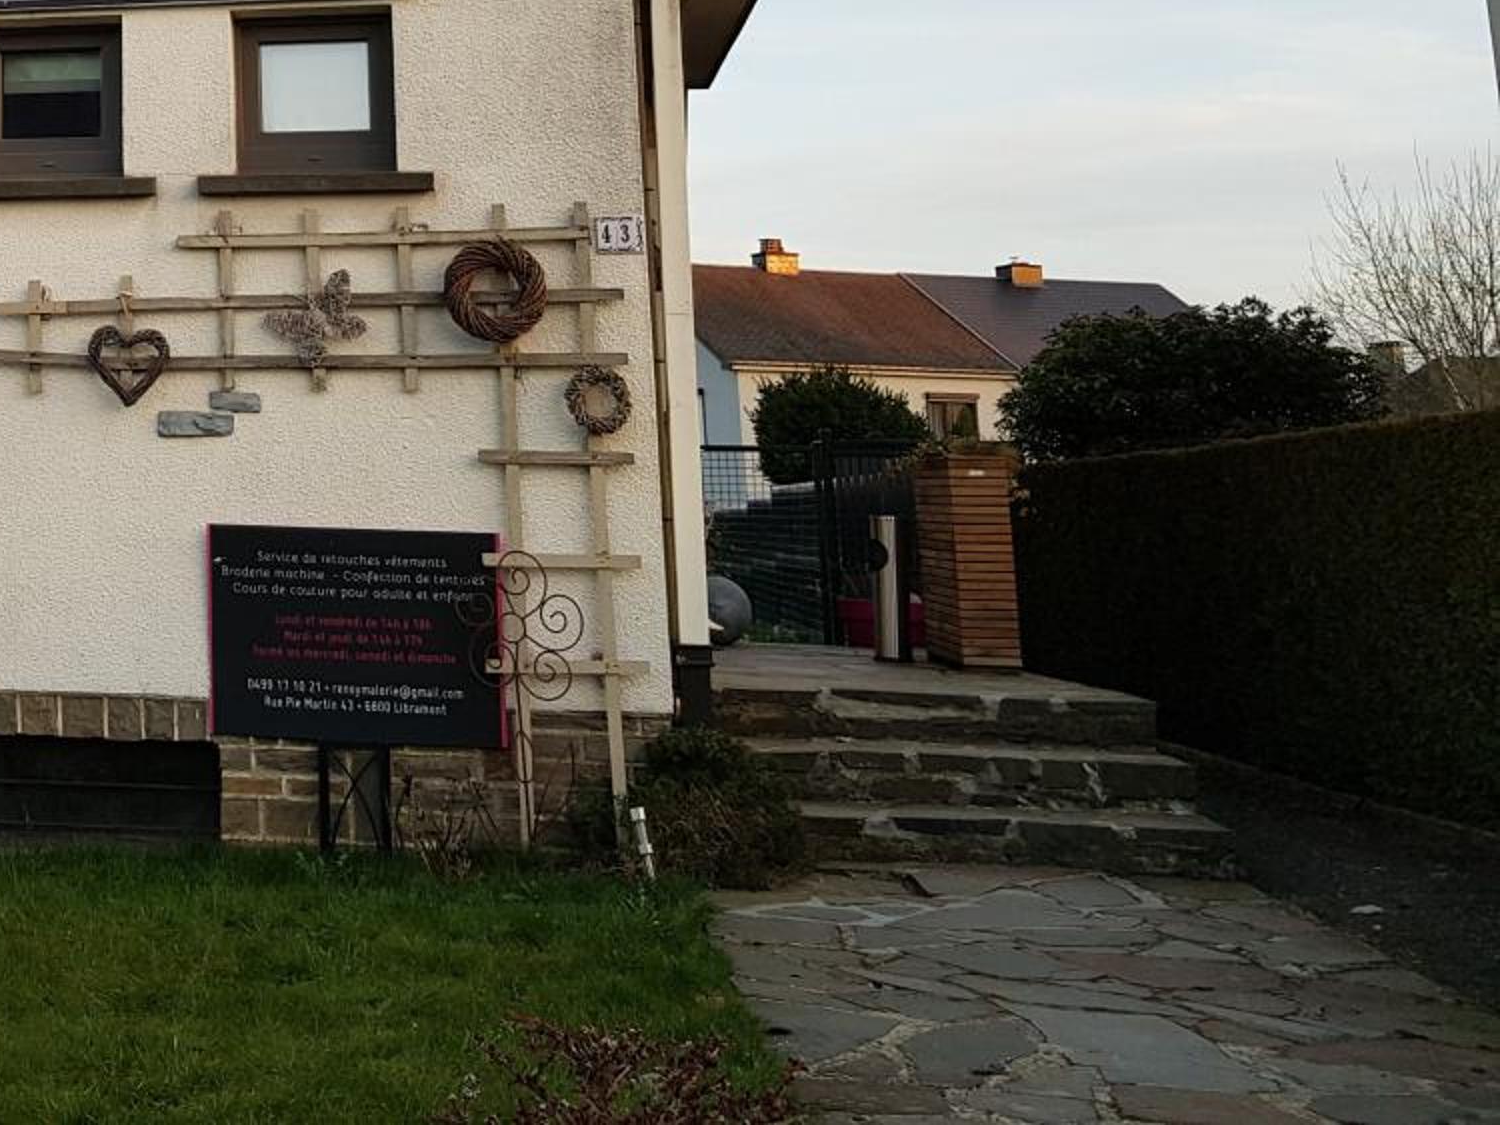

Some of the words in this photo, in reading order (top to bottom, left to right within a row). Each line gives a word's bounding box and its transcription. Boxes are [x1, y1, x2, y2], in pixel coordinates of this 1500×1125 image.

[601, 223, 630, 244] 43
[257, 549, 299, 563] Service
[301, 553, 317, 564] de
[320, 554, 380, 567] retouches
[384, 555, 448, 568] vêtements
[221, 565, 271, 578] Broderie
[273, 569, 325, 580] machine
[343, 570, 411, 585] Confection
[415, 573, 430, 585] de
[232, 582, 268, 594] Cours
[270, 583, 286, 595] de
[289, 586, 336, 597] couture
[341, 588, 368, 600] pour
[415, 590, 428, 601] et
